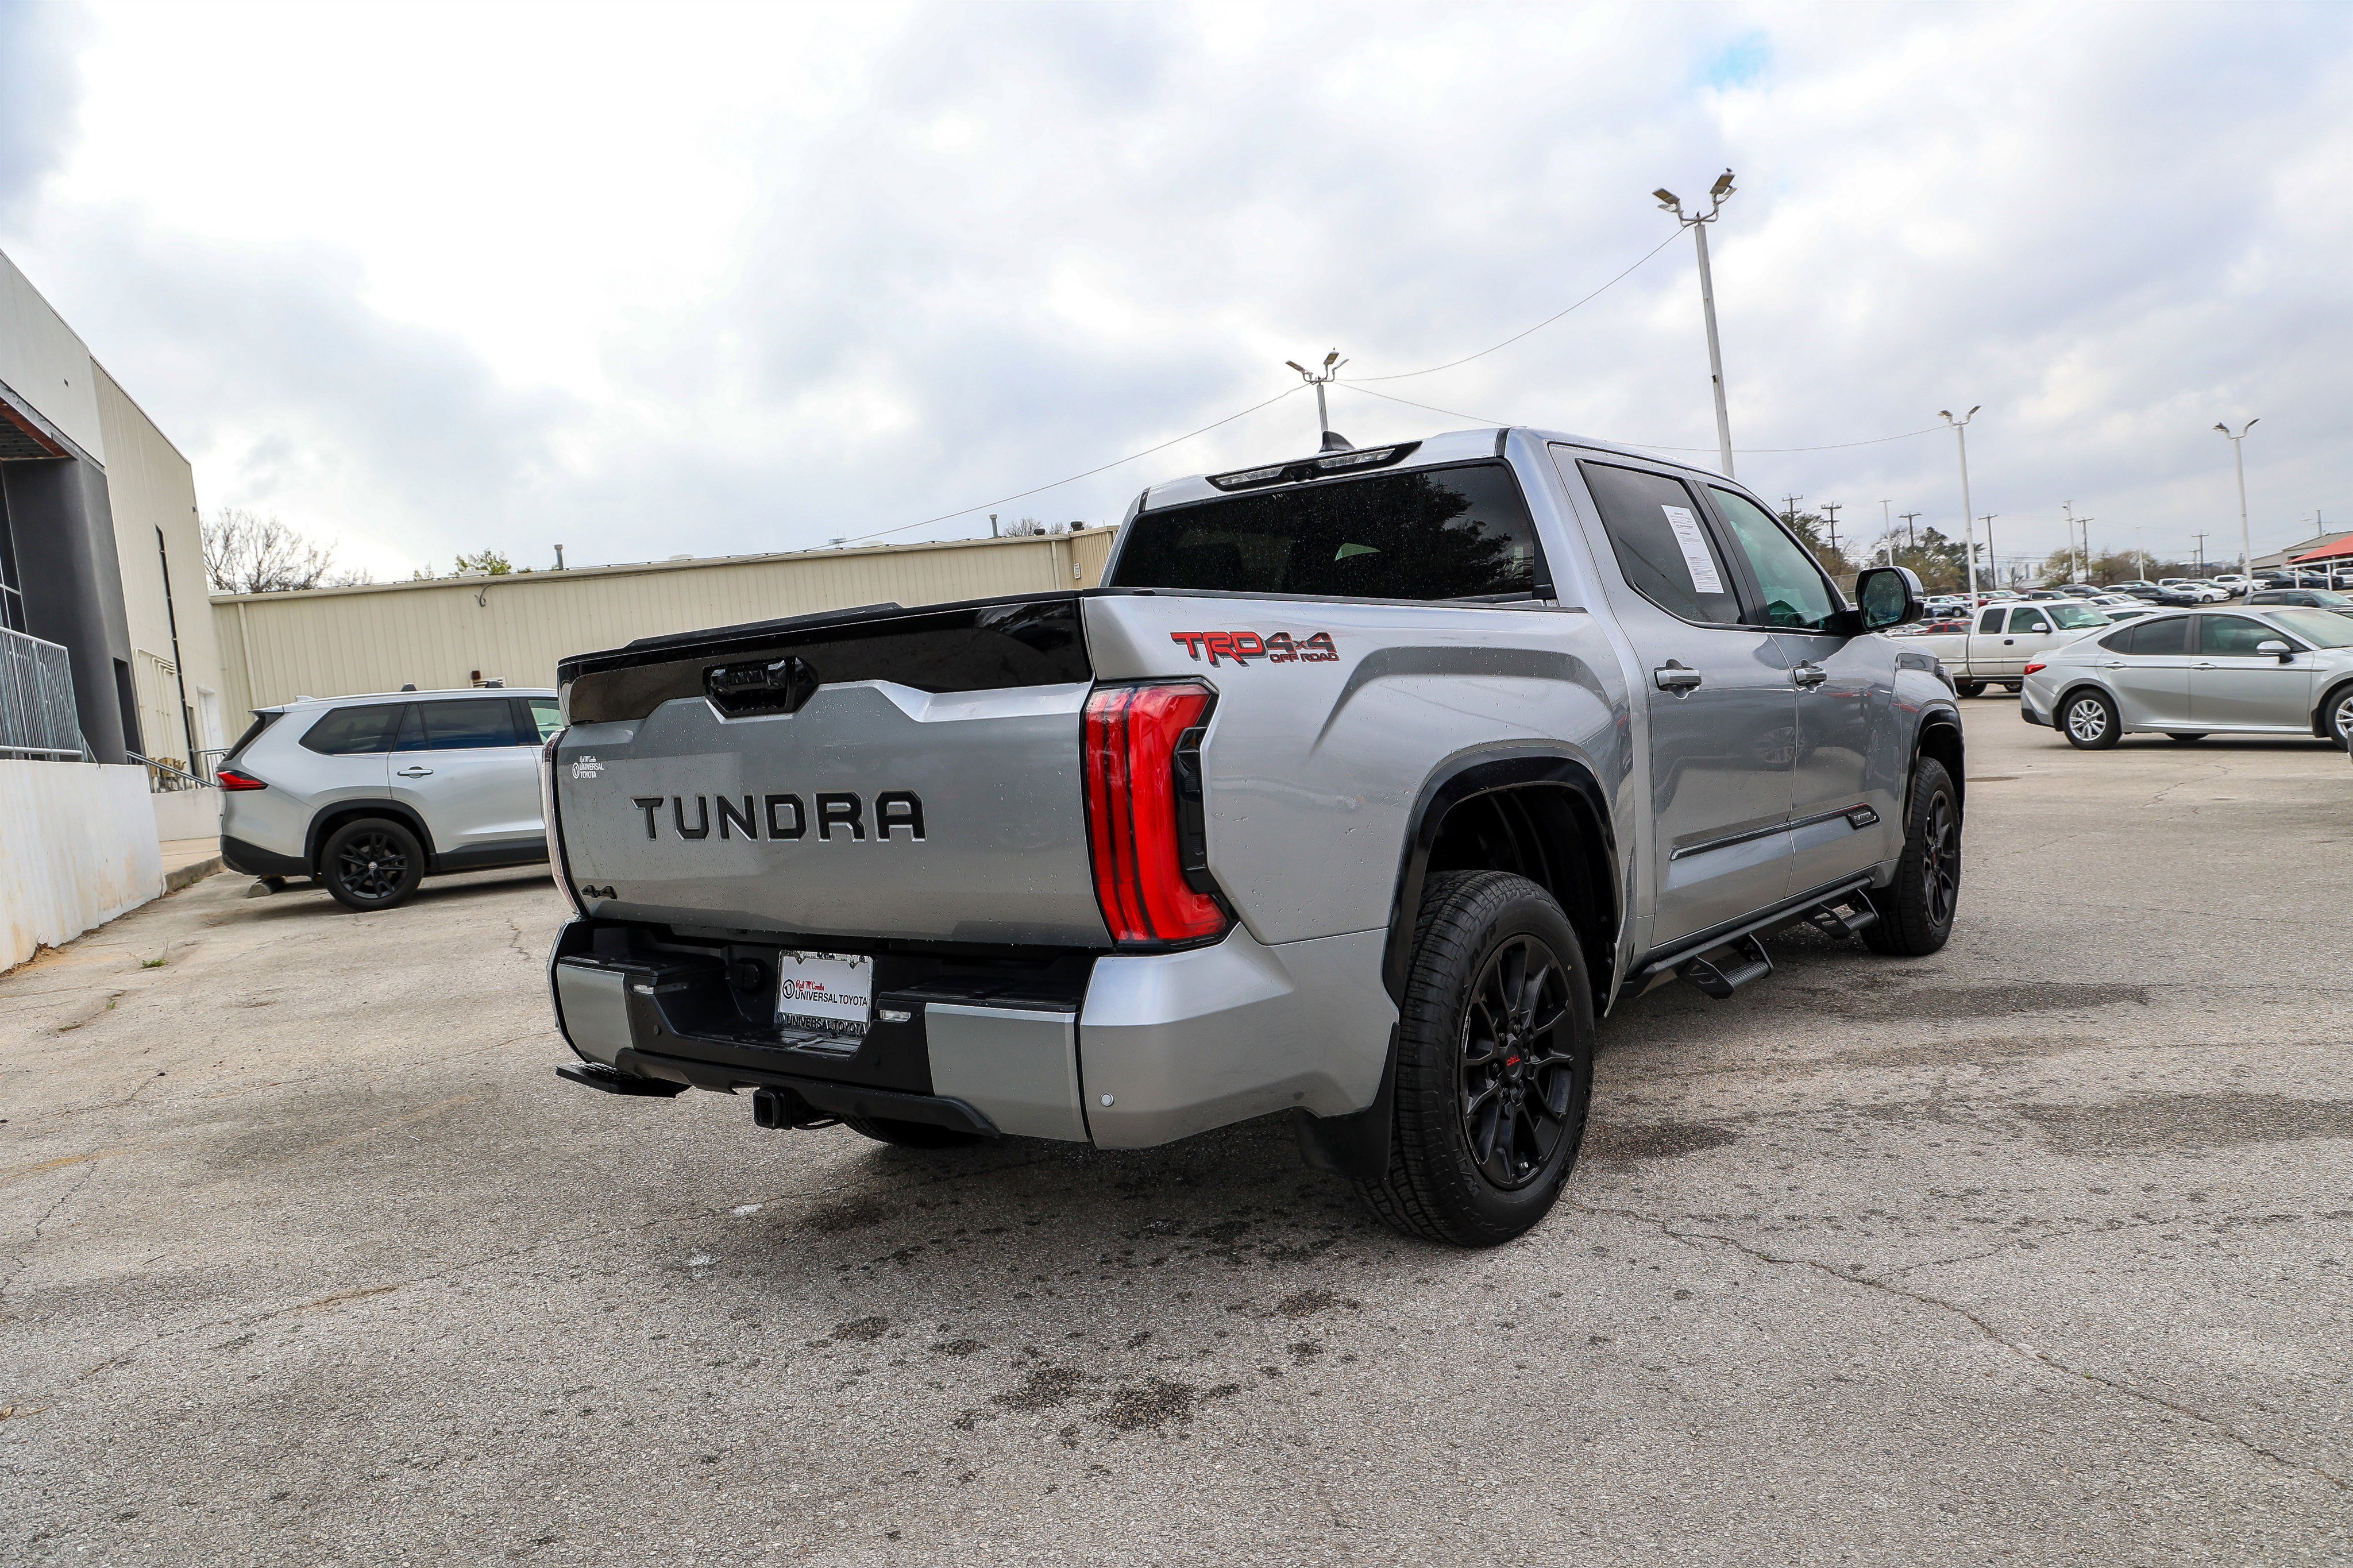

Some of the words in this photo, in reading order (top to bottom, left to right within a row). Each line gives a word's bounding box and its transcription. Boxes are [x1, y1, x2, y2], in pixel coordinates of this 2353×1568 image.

[1170, 631, 1268, 668] TRD
[1269, 653, 1299, 663] OFF
[1300, 653, 1340, 662] ROAD
[631, 789, 927, 843] TUNDRA
[796, 979, 805, 991] Red
[795, 991, 838, 1003] UNIVERSAL
[839, 994, 867, 1006] TOYOTA
[786, 1015, 832, 1030] UNIVERSAL
[833, 1021, 866, 1034] TOYOTA
